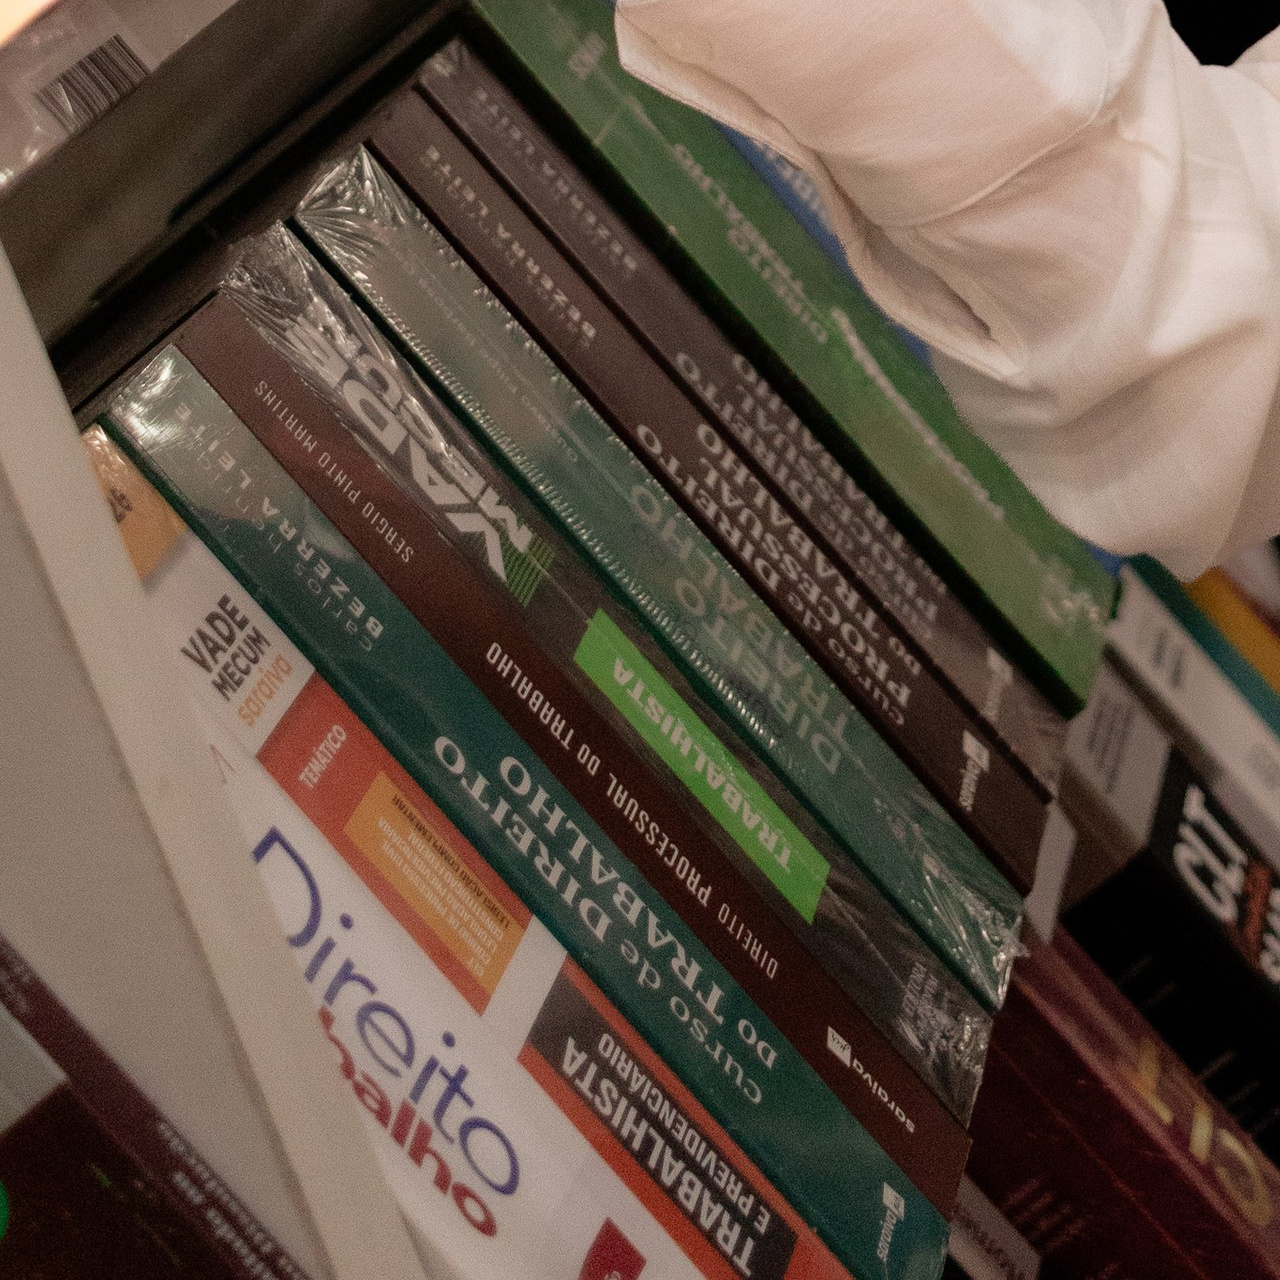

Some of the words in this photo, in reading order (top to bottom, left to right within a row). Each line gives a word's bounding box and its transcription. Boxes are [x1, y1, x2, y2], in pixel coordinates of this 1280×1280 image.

[426, 144, 489, 218] LEITE
[495, 221, 597, 340] BEZERRA
[173, 399, 252, 491] LEITE
[254, 378, 318, 453] MARTINS
[284, 311, 505, 583] VADE
[674, 348, 813, 512] DIREITO
[175, 427, 285, 555] henriq
[316, 449, 361, 504] PINTO
[635, 420, 781, 592] DIREITO
[733, 381, 937, 623] PROCESSUAL
[258, 494, 384, 639] BEZERRA
[360, 499, 414, 564] SERGIO
[693, 419, 879, 641] TRABALHO
[696, 455, 911, 708] PROCESSUAL
[180, 593, 252, 674] VADE
[290, 560, 373, 654] carlos
[626, 479, 850, 745] TRABALHO
[783, 589, 823, 636] de
[212, 625, 270, 702] MECUM
[236, 651, 293, 727] saraiva
[486, 639, 575, 751] TRABALHO
[669, 573, 841, 776] DIREITO
[826, 635, 905, 727] curso
[297, 722, 347, 787] TEMÁTICO
[576, 741, 600, 777] DO
[610, 655, 792, 875] TRABALHISTA
[391, 792, 460, 874] COMPLEMENTAR
[431, 731, 612, 943] DIREITO
[604, 771, 711, 907] PROCESSUAL
[1174, 783, 1250, 923] CLT
[459, 867, 510, 929] LEGISLAÇÃO
[495, 751, 729, 1025] TRABALHO
[618, 938, 664, 994] de
[716, 901, 778, 981] DIREITO
[252, 826, 520, 1196] Direito
[666, 992, 764, 1106] curso
[734, 1015, 777, 1070] DO
[597, 1031, 754, 1219] PREVIDENCIÁRIO
[851, 1056, 917, 1134] saraiva
[562, 1034, 752, 1278] TRABALHISTA
[750, 1205, 771, 1235] E
[875, 1208, 897, 1263] saraiva
